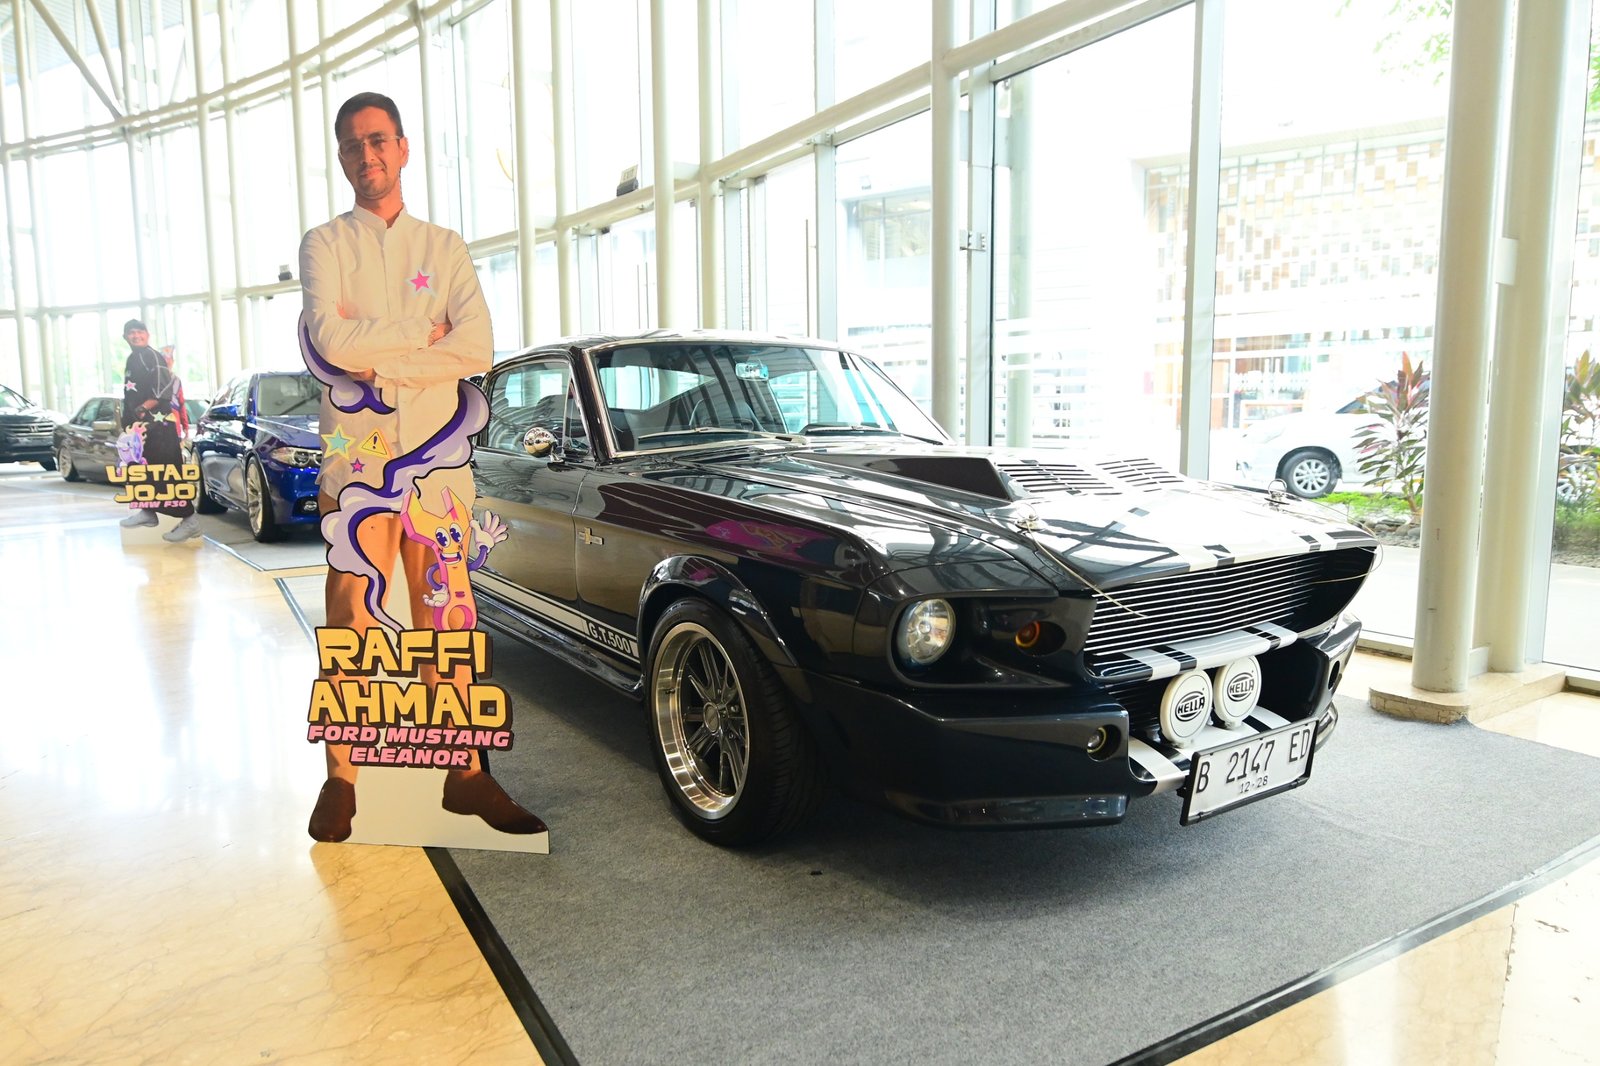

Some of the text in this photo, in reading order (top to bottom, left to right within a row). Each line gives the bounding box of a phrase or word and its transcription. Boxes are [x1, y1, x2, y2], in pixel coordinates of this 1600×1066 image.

[106, 464, 200, 483] USTAD
[114, 483, 196, 502] JOJO
[130, 500, 188, 509] BMW F30
[315, 627, 489, 675] RAFFI
[1229, 679, 1255, 693] HELLA
[309, 680, 508, 728] AHMAD
[1177, 697, 1205, 715] HELLA
[308, 725, 511, 748] FORD MUSTANG
[350, 747, 470, 767] ELEANOR
[1196, 728, 1311, 794] B 2147 ED
